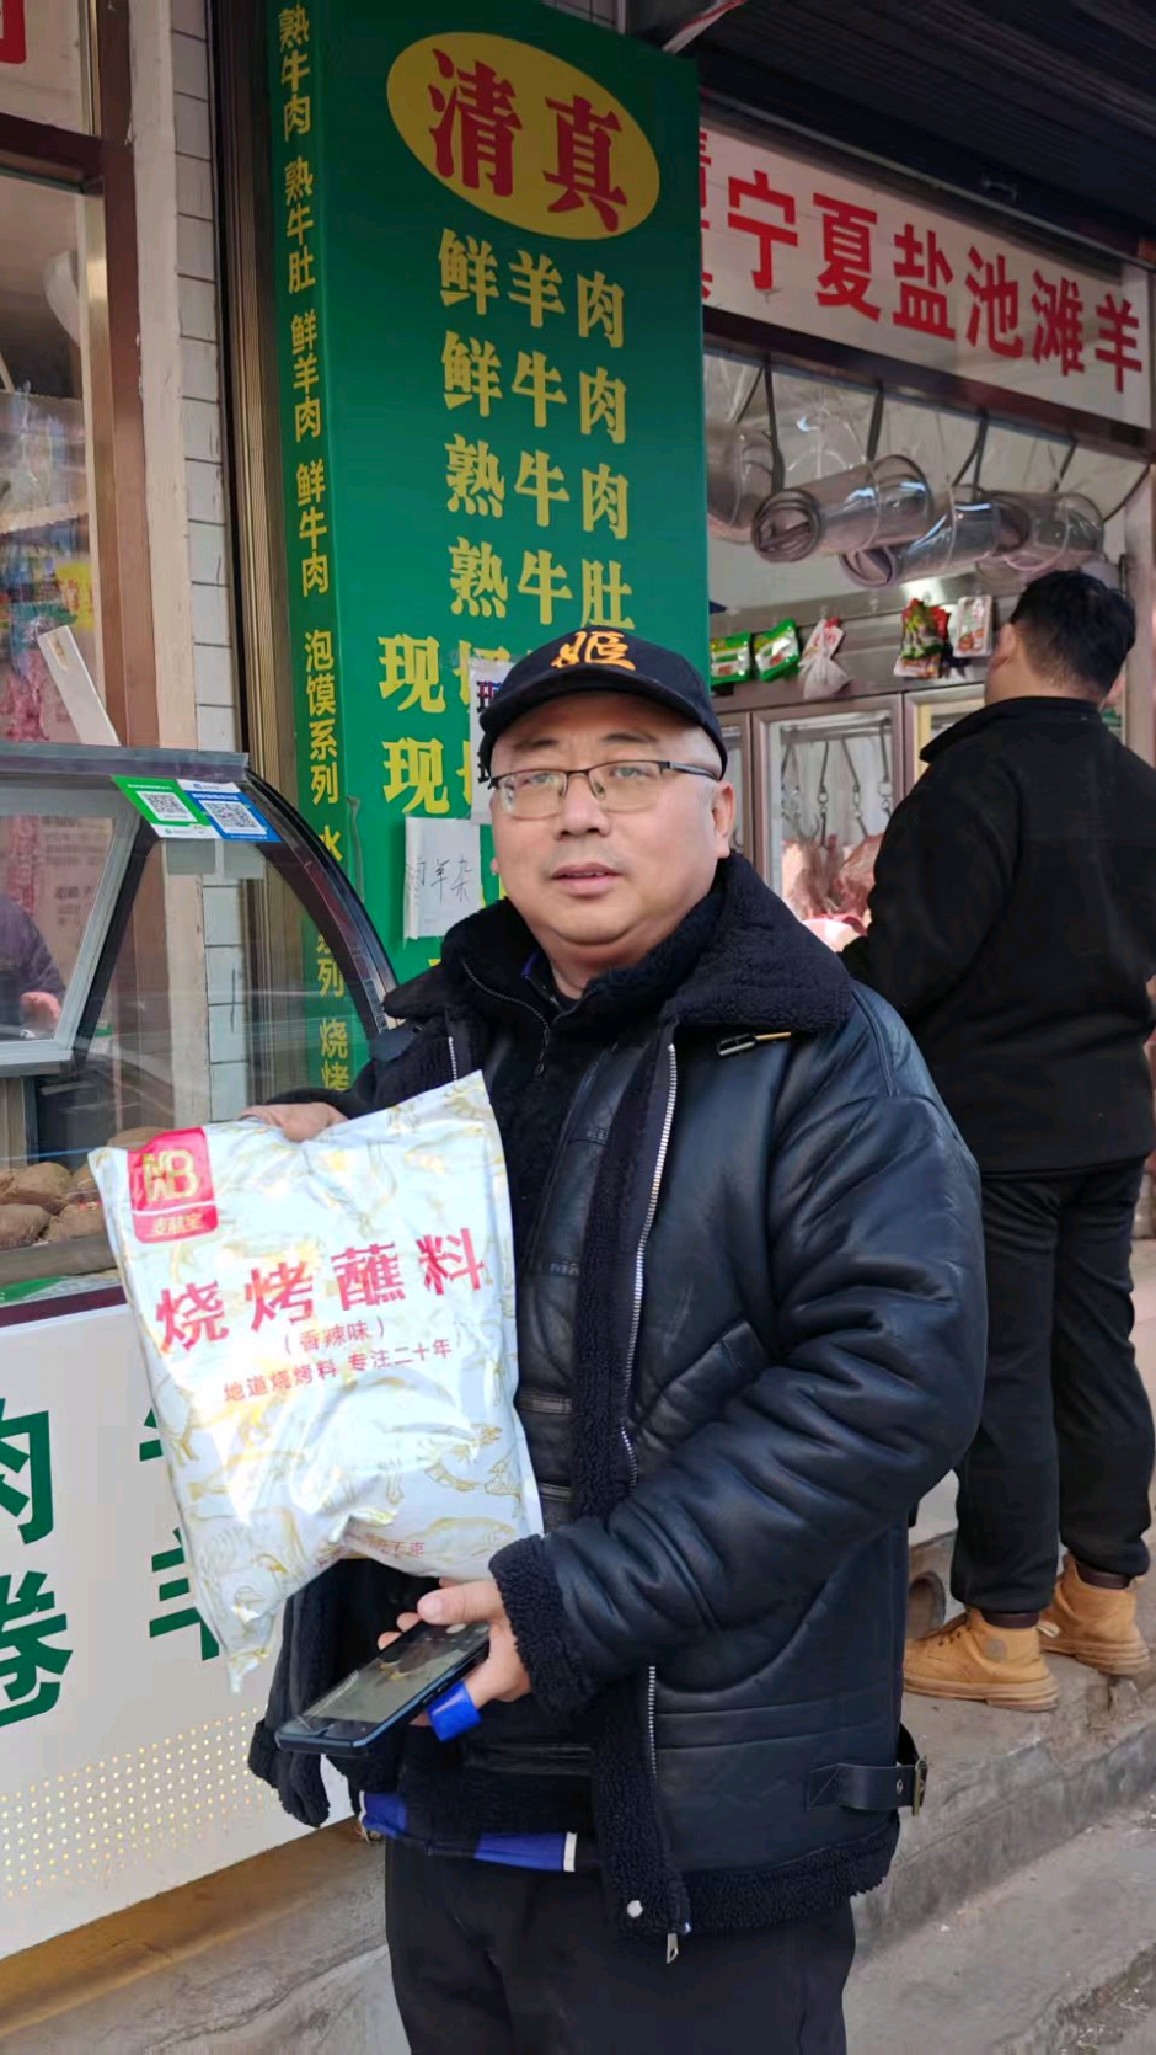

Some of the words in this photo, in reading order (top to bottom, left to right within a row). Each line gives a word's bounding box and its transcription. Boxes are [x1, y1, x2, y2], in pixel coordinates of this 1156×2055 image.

[278, 3, 312, 143] 熟牛肉
[427, 48, 629, 233] 清真
[284, 155, 316, 294] 熟牛肚
[438, 227, 625, 348] 鲜羊肉
[727, 169, 1143, 394] 宁夏盐池滩羊
[290, 308, 322, 443] 鲜羊肉
[441, 329, 627, 444] 鲜牛肉
[296, 458, 328, 597] 鲜牛肉
[444, 433, 629, 540] 熟牛肉
[448, 536, 636, 630] 熟牛肚
[304, 629, 339, 805] 泡馍系列
[155, 1227, 484, 1354] 烧烤蘸料
[348, 1338, 452, 1372] 专注二十年
